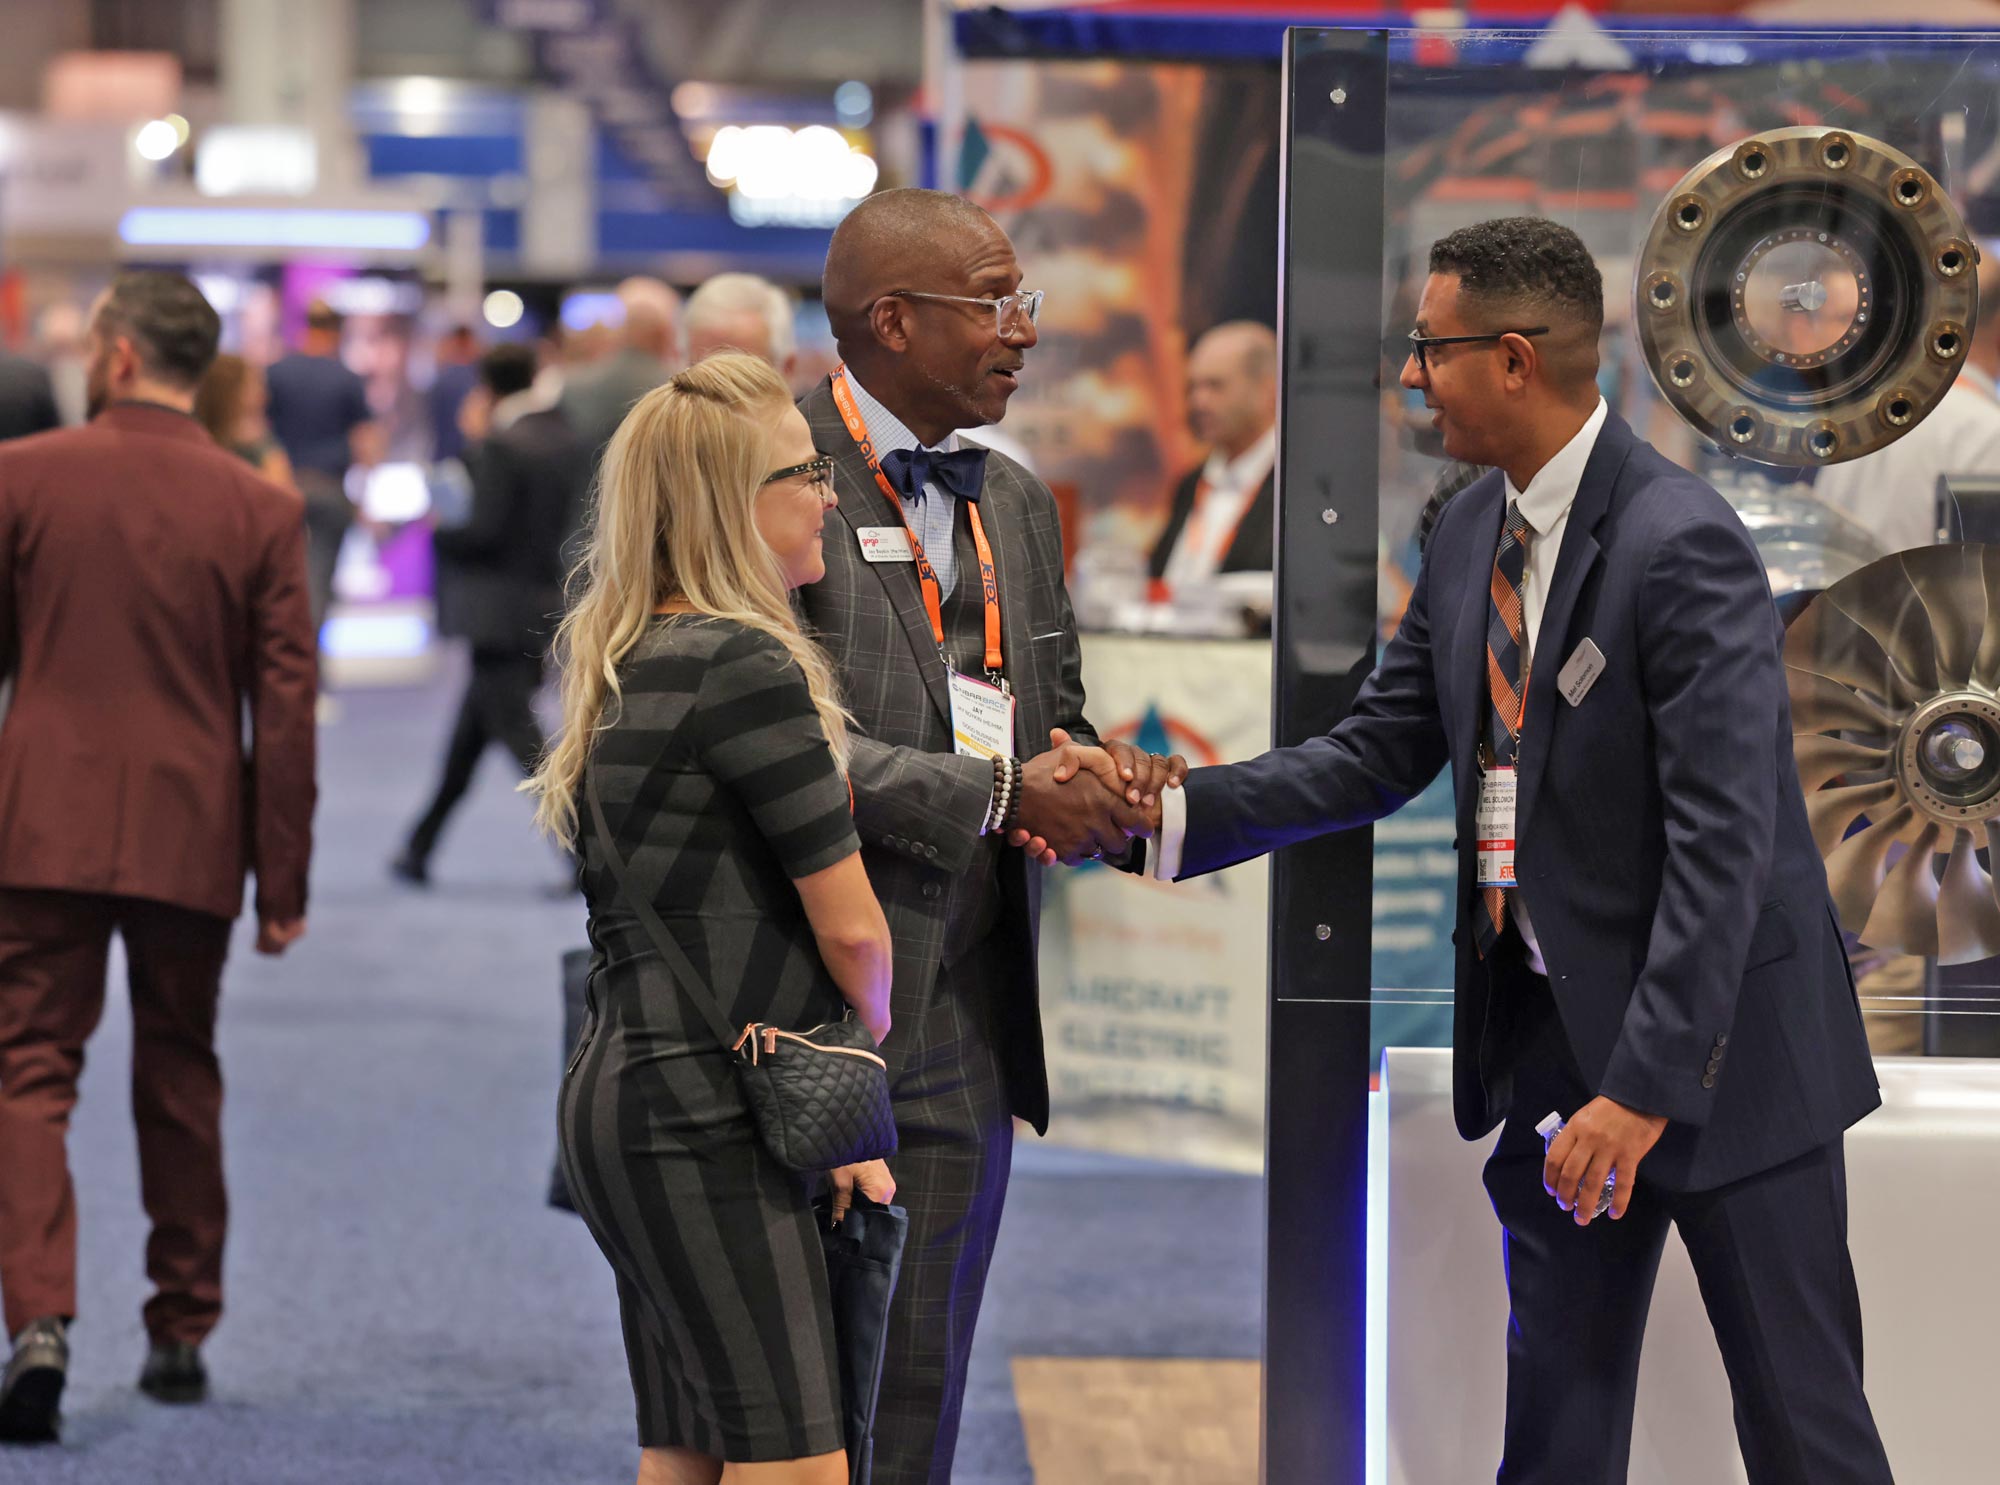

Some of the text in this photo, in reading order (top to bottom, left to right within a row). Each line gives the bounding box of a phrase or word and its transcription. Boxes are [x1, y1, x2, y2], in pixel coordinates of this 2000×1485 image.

[861, 538, 879, 547] gogo
[1568, 686, 1577, 697] Mel
[1576, 664, 1594, 687] Solomon
[972, 706, 983, 716] JAY
[1500, 866, 1515, 879] JETE
